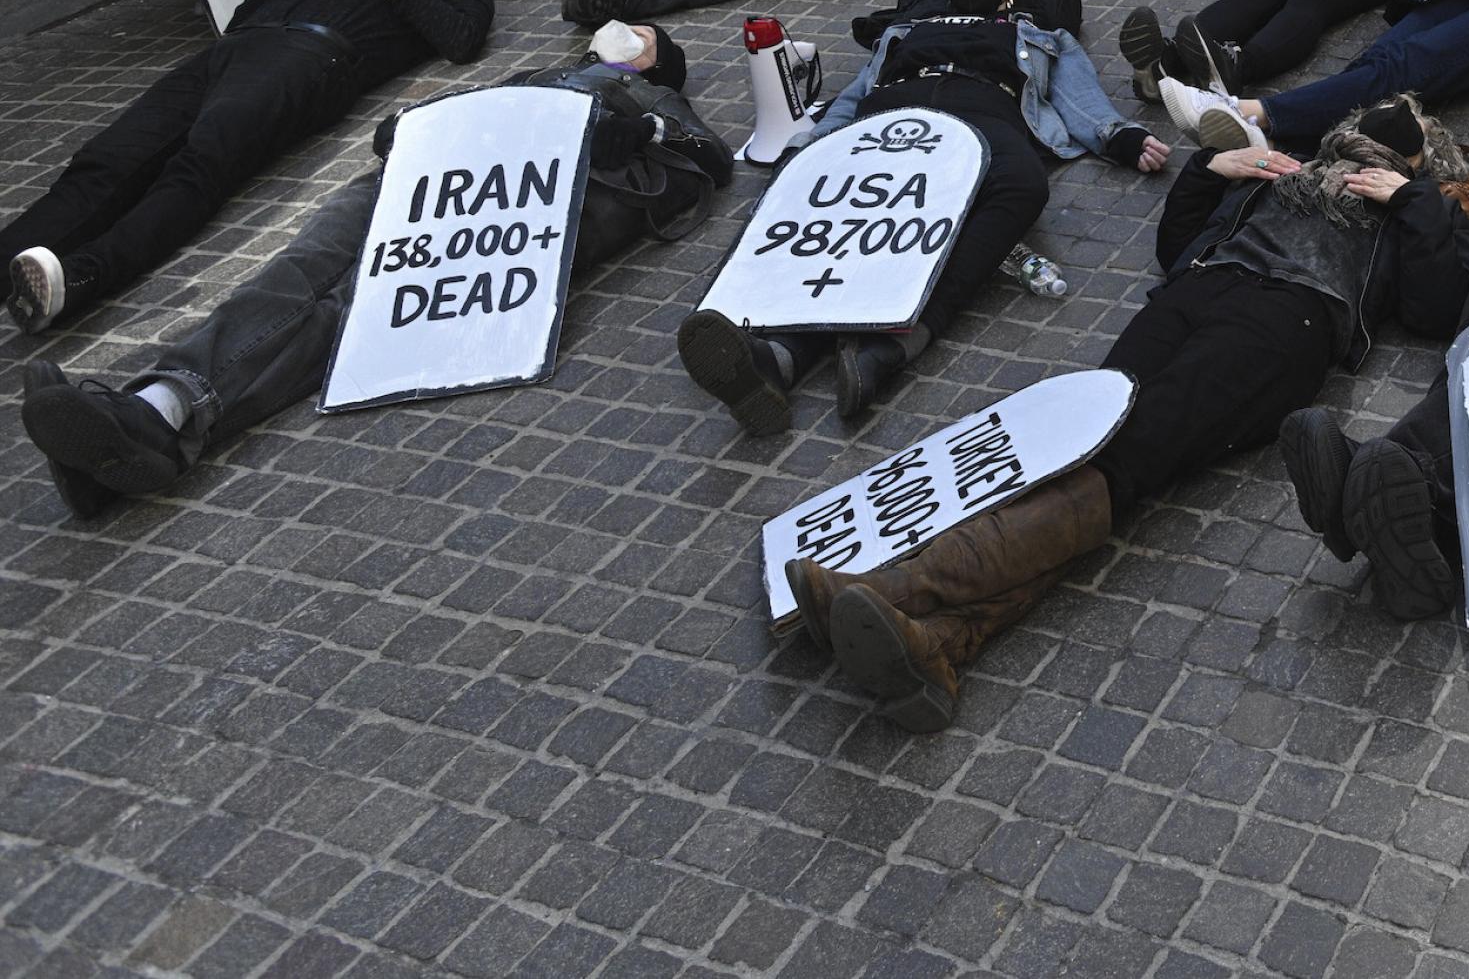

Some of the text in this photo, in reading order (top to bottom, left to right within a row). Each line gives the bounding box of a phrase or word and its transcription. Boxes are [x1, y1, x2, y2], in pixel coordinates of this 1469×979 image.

[408, 158, 560, 222] IRAN
[808, 173, 927, 208] USA
[369, 222, 560, 277] 138,000+
[754, 217, 953, 260] 987,000
[391, 267, 537, 328] DEAD
[802, 267, 844, 298] +
[945, 412, 1026, 511] TURKEY
[866, 447, 940, 549] 96,000+
[796, 494, 862, 570] DEAD
